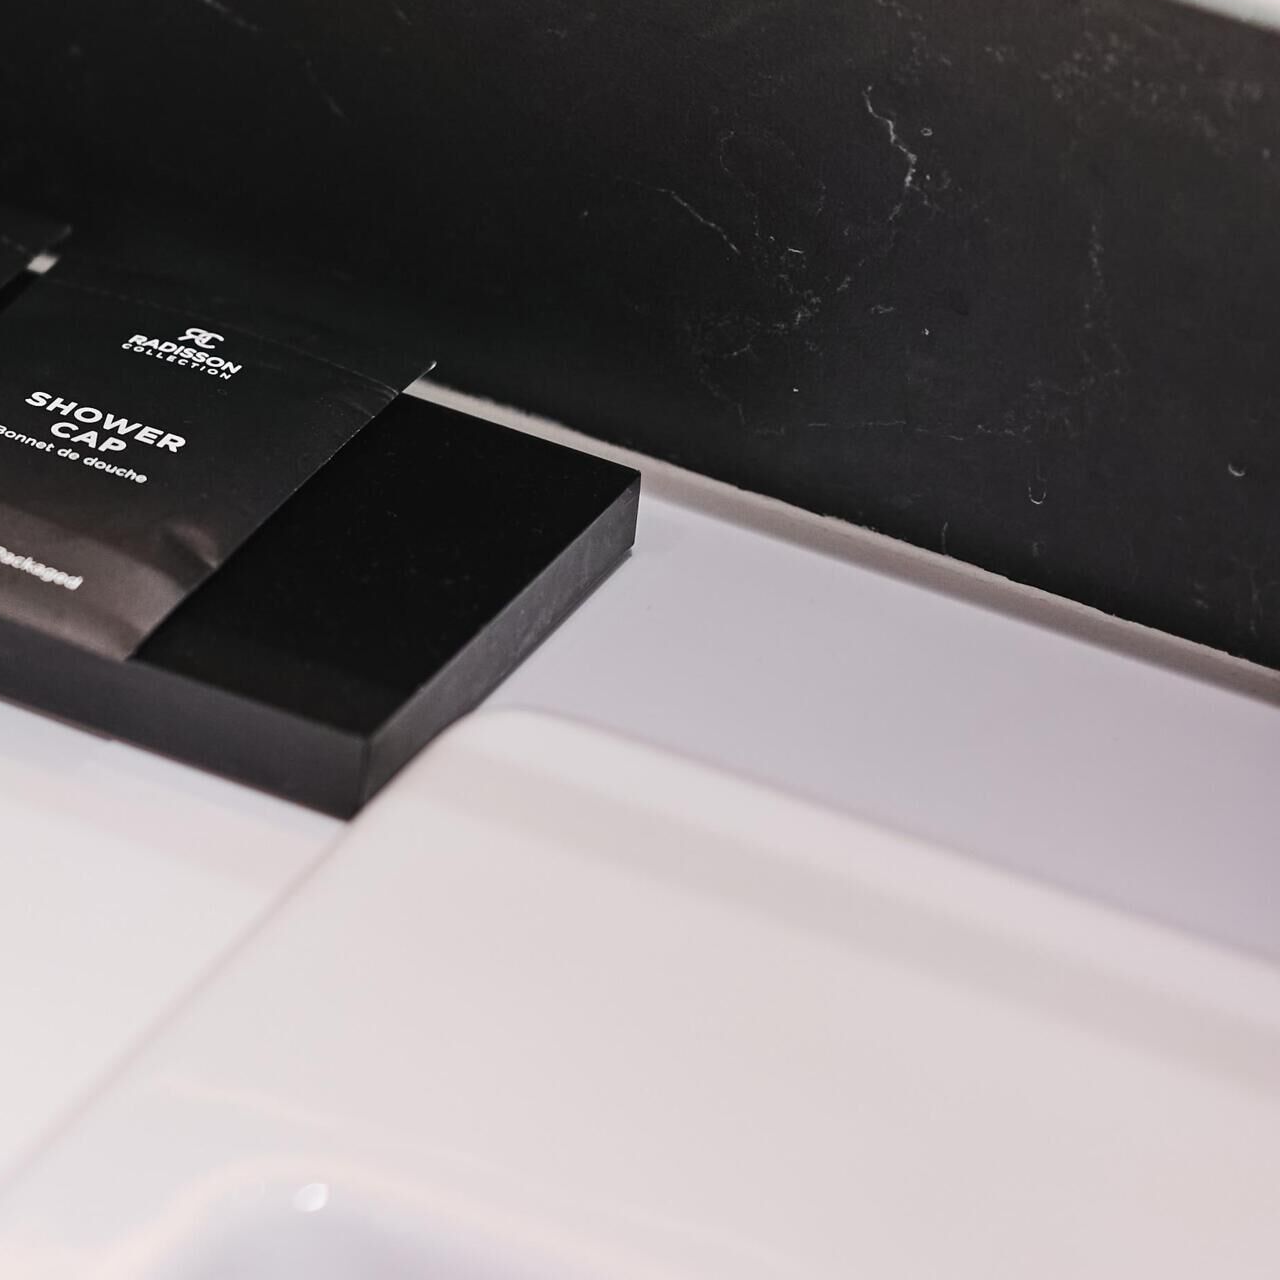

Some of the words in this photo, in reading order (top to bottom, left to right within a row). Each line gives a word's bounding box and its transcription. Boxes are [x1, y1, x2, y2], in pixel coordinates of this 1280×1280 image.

[121, 343, 232, 380] COLLECTION
[128, 334, 243, 374] RADISSON
[24, 391, 187, 453] SHOWER
[50, 422, 127, 453] CAP
[57, 448, 81, 461] de
[83, 457, 148, 484] douche
